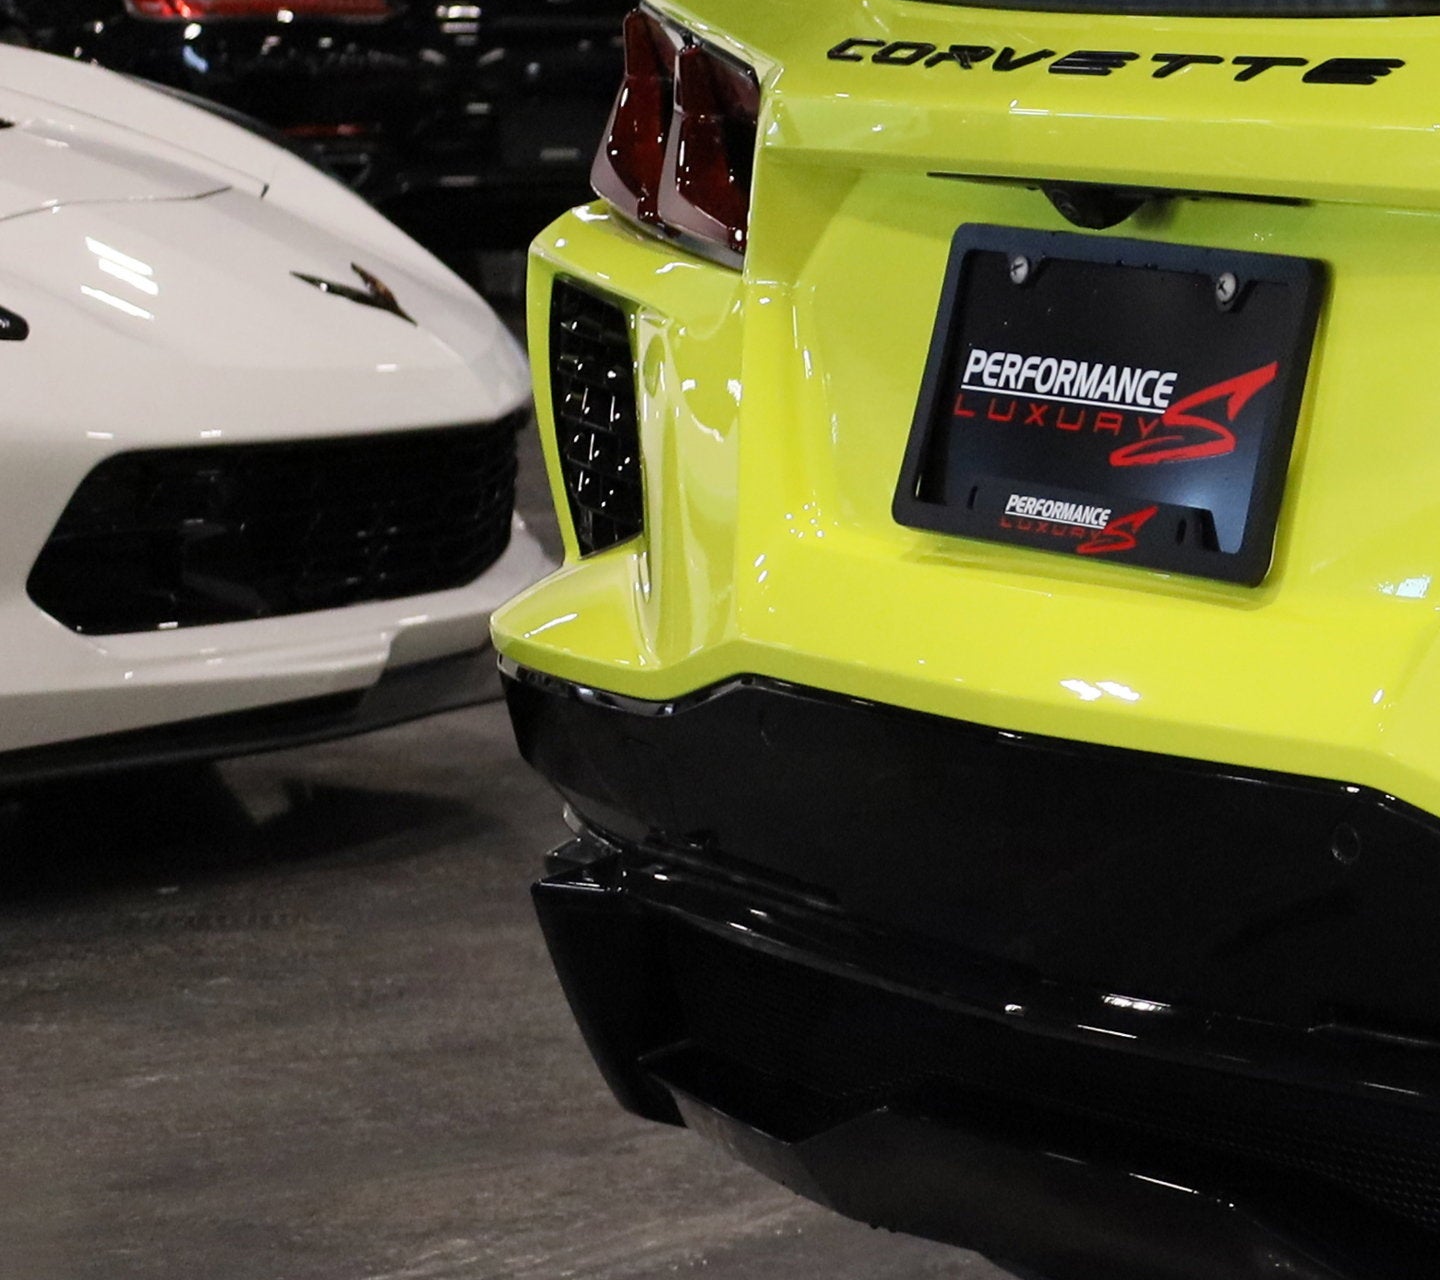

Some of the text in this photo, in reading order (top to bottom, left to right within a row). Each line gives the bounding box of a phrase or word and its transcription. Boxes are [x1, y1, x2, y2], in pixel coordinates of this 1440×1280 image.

[826, 37, 1406, 85] CORVETTE
[962, 348, 1178, 409] PERFORMANCE
[953, 393, 1162, 439] LUXURY
[1004, 494, 1112, 526] PERFORMANCE
